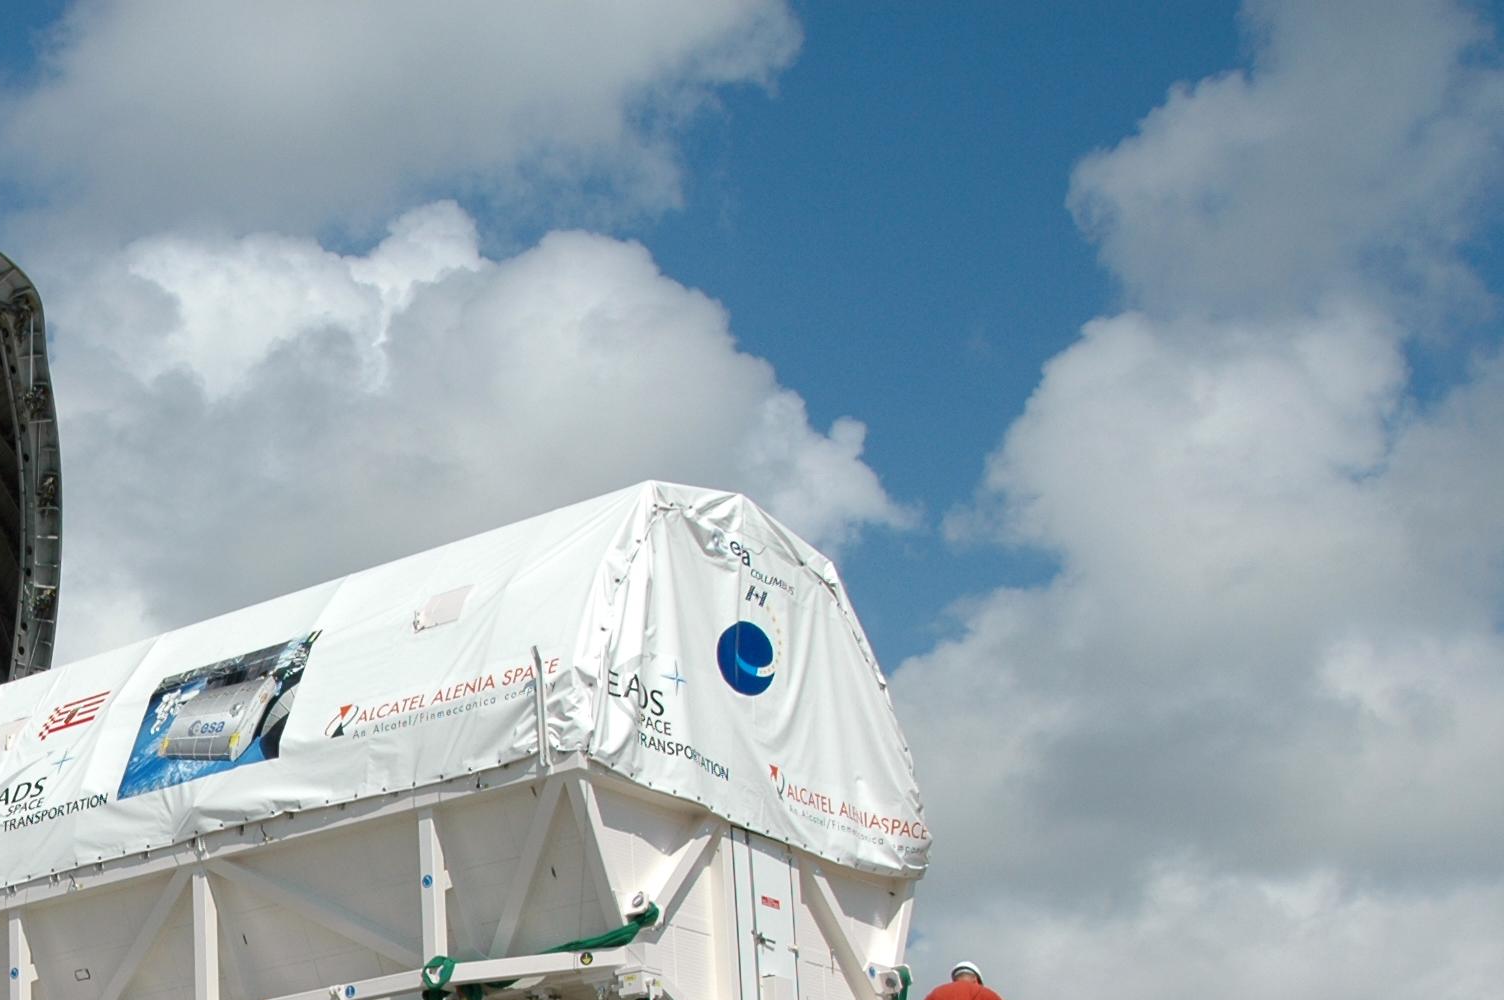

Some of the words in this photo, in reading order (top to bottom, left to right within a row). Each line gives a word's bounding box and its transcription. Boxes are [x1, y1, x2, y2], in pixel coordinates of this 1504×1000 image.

[356, 695, 426, 724] ALCATEL
[431, 674, 496, 706] ALENIA
[502, 658, 559, 687] SPAE
[201, 721, 225, 734] esa
[3, 793, 108, 832] TRANSPORTATION
[6, 797, 44, 817] SPACE
[787, 784, 834, 815] ALCATEL
